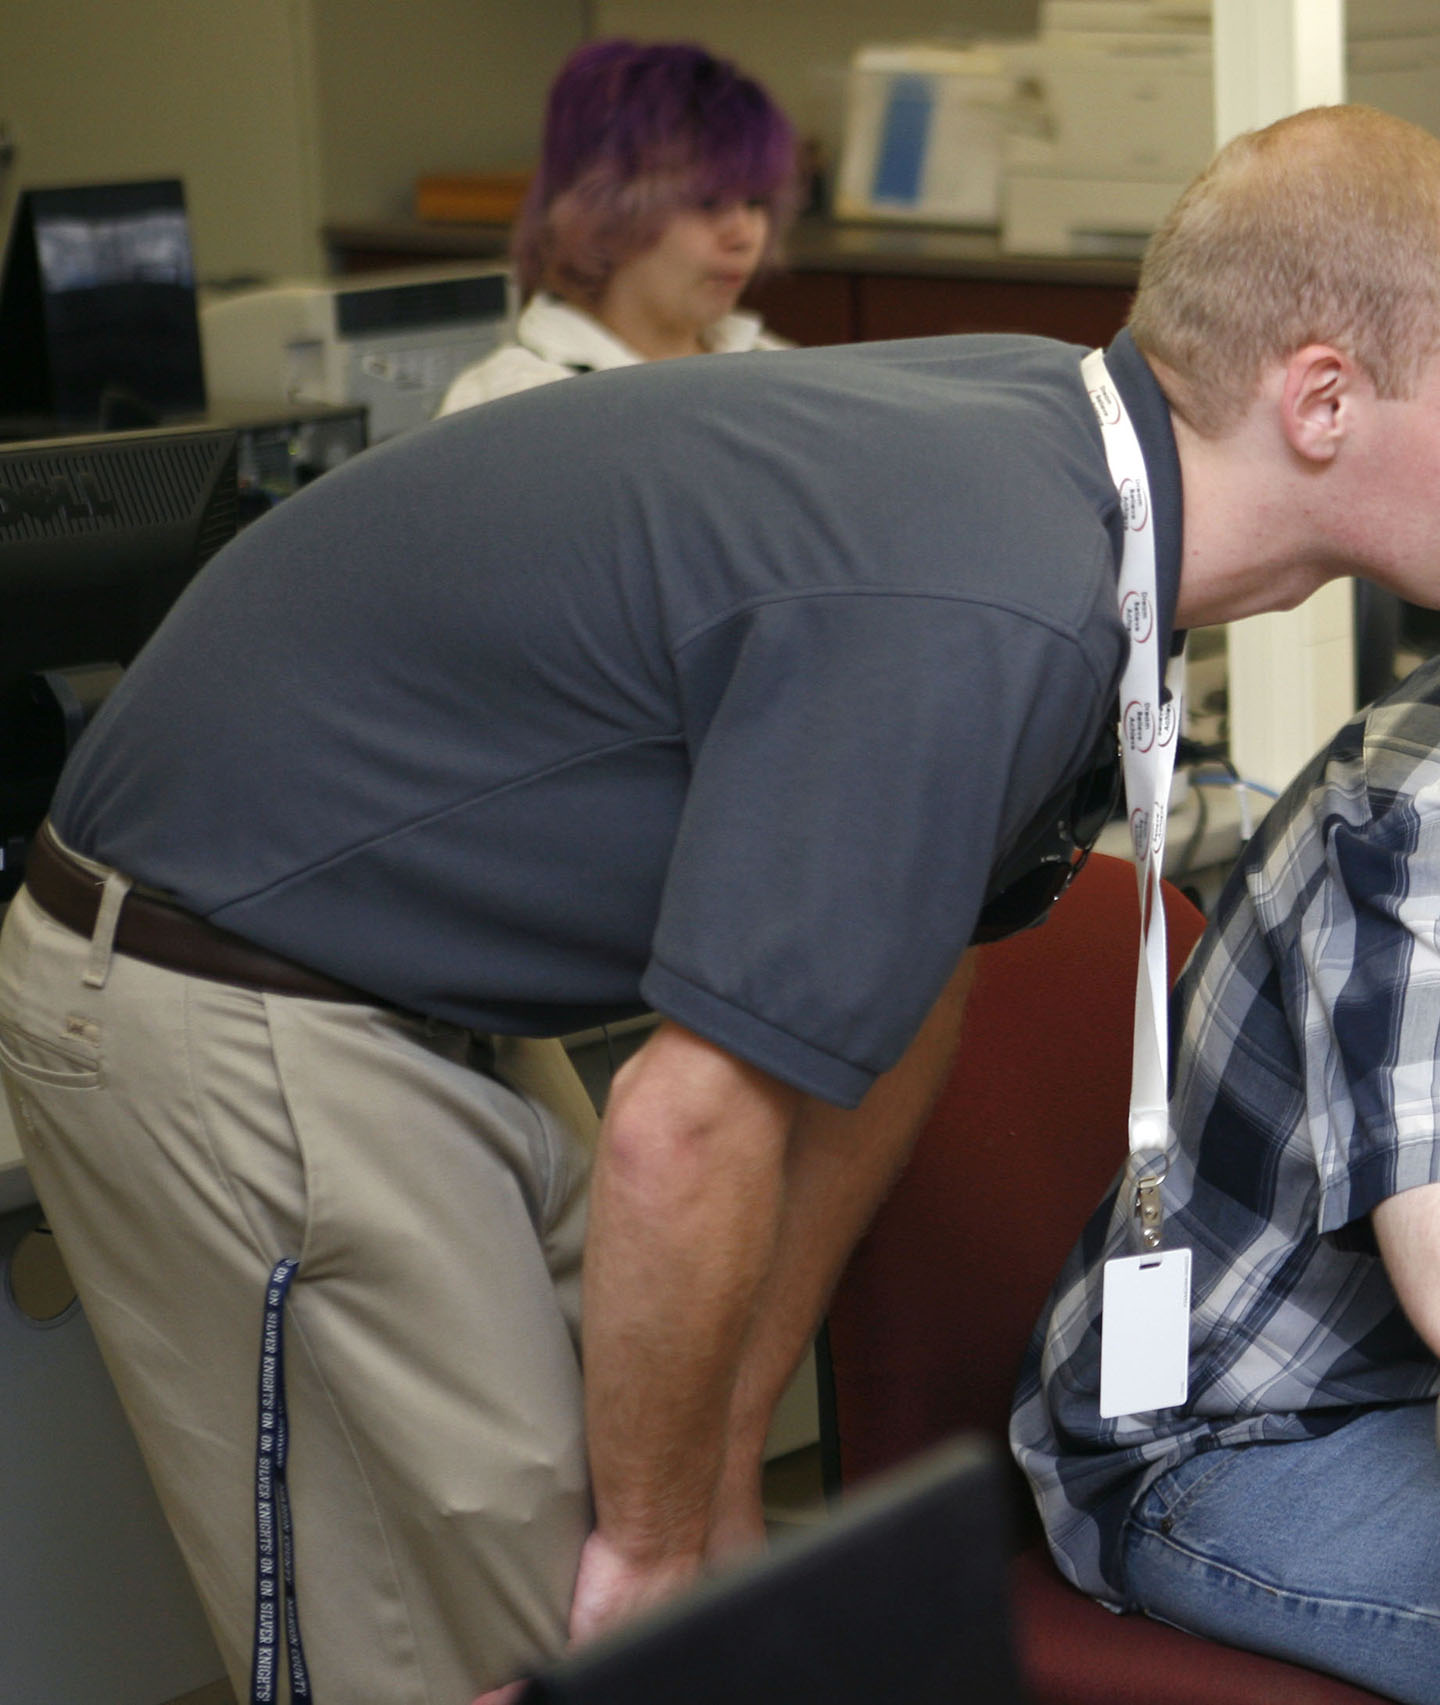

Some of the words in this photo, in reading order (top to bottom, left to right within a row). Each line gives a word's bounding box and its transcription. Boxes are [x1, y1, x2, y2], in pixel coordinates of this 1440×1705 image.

[266, 1312, 279, 1353] SILVER
[259, 1458, 270, 1498] SILVER
[259, 1602, 273, 1643] SILVER
[290, 1648, 306, 1697] COUNTY
